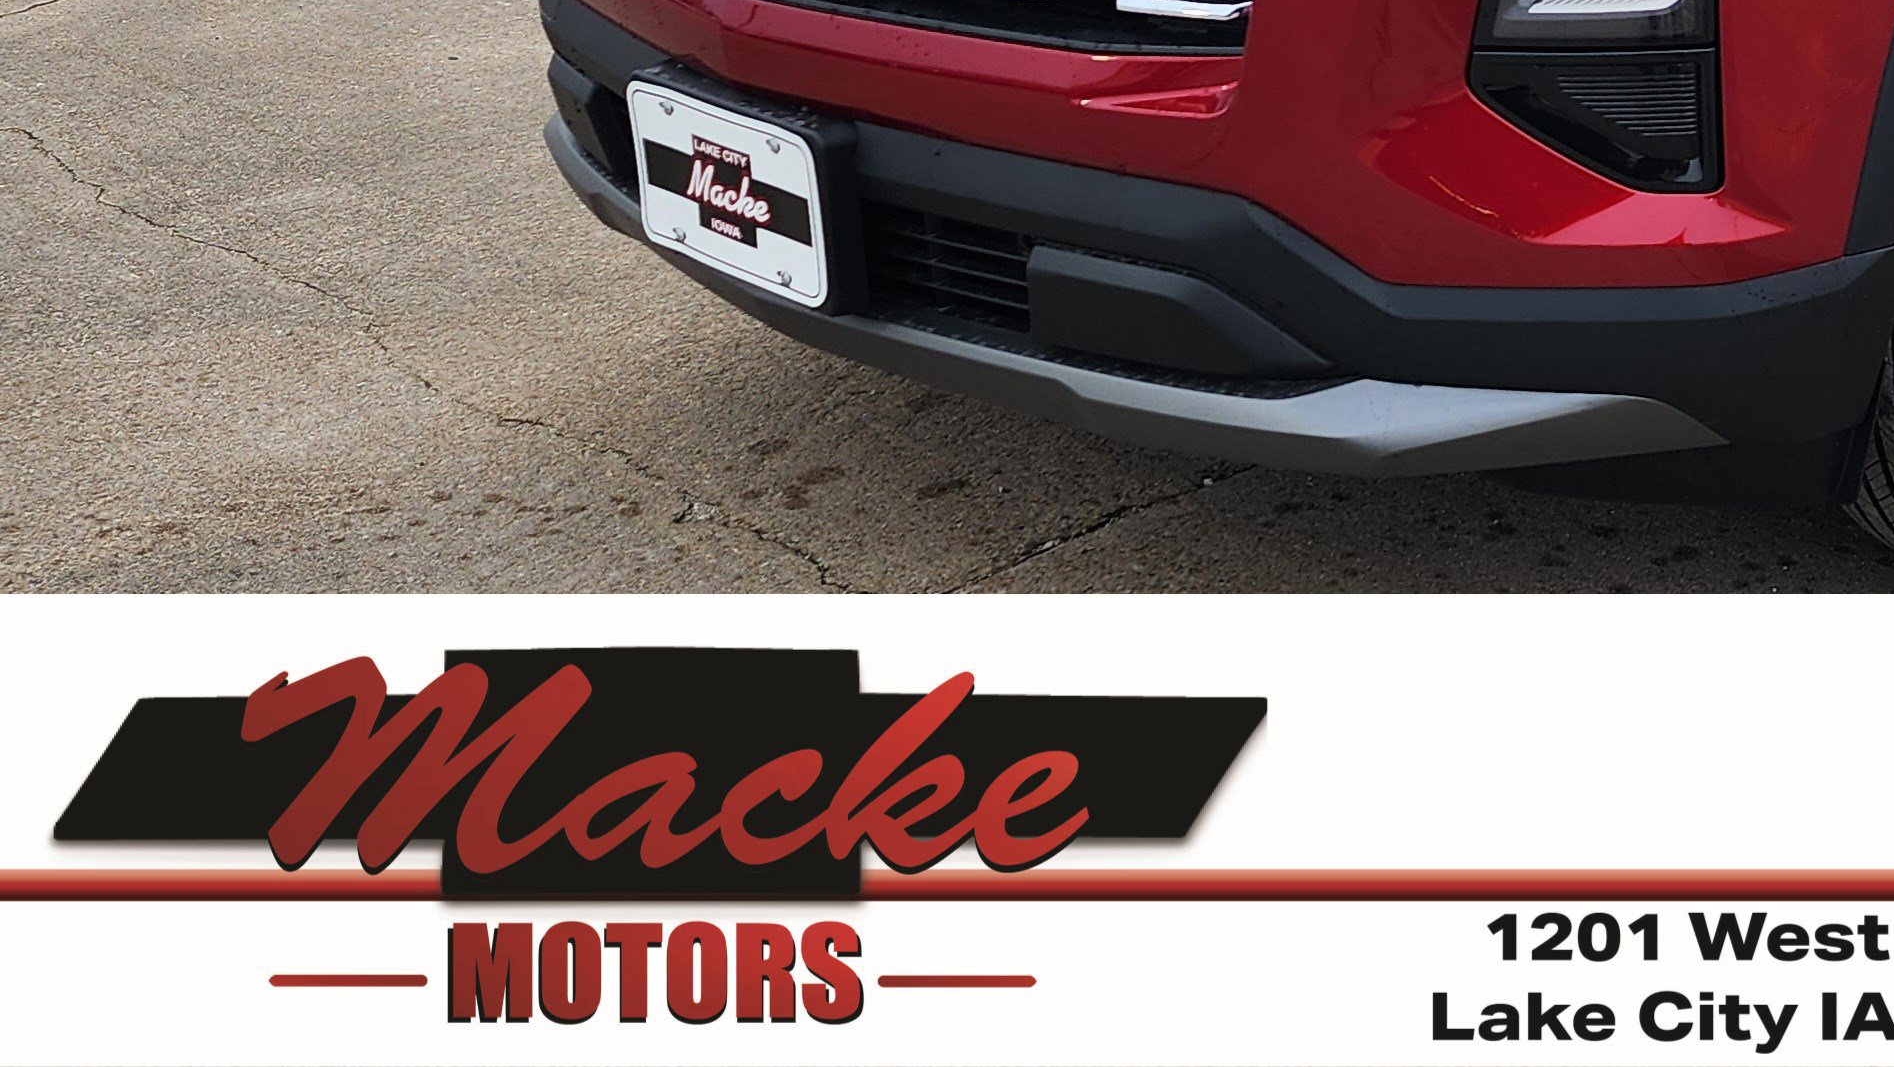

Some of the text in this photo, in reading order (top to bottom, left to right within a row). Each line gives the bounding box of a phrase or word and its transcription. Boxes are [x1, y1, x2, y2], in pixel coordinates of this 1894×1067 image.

[693, 138, 750, 168] LAKE CITY
[687, 159, 771, 222] Macke
[711, 217, 743, 240] IOWA
